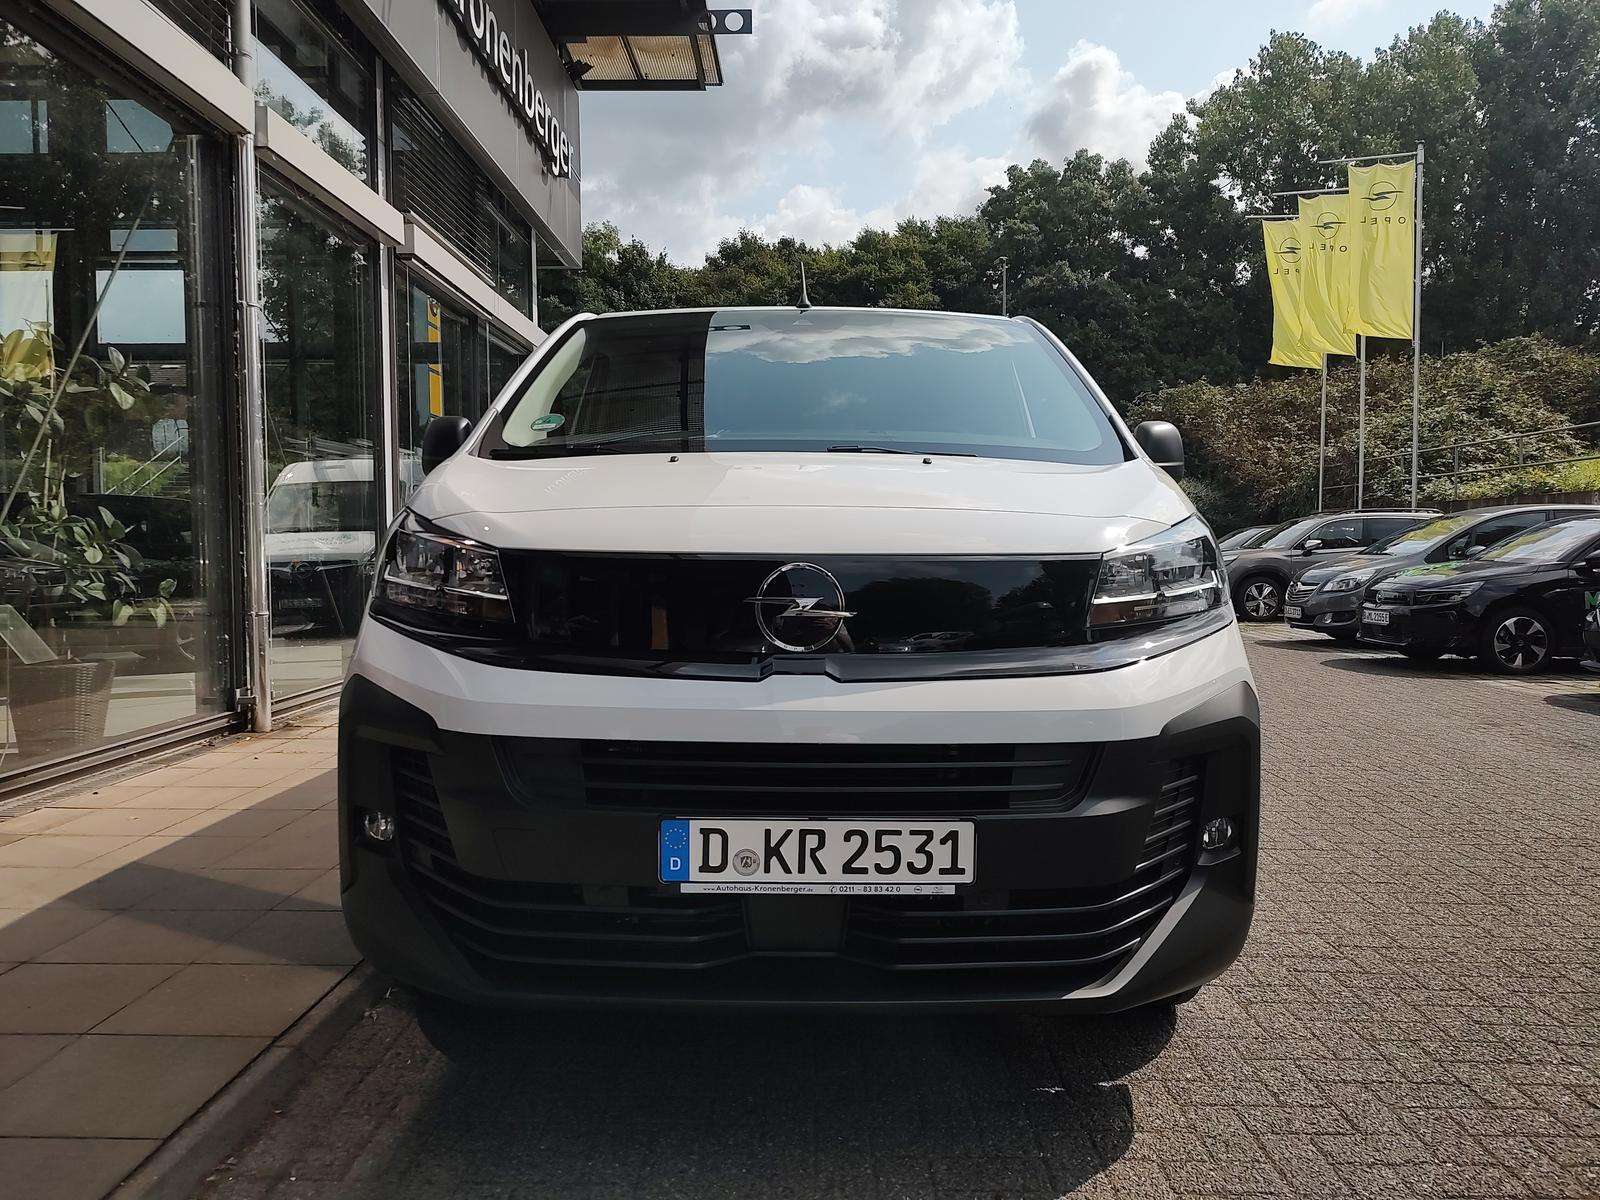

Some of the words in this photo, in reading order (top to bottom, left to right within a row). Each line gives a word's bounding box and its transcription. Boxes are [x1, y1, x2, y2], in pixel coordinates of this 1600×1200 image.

[454, 0, 574, 180] onenberger
[670, 858, 681, 870] D
[698, 828, 729, 875] D
[763, 828, 828, 875] KR
[841, 829, 966, 876] 2531
